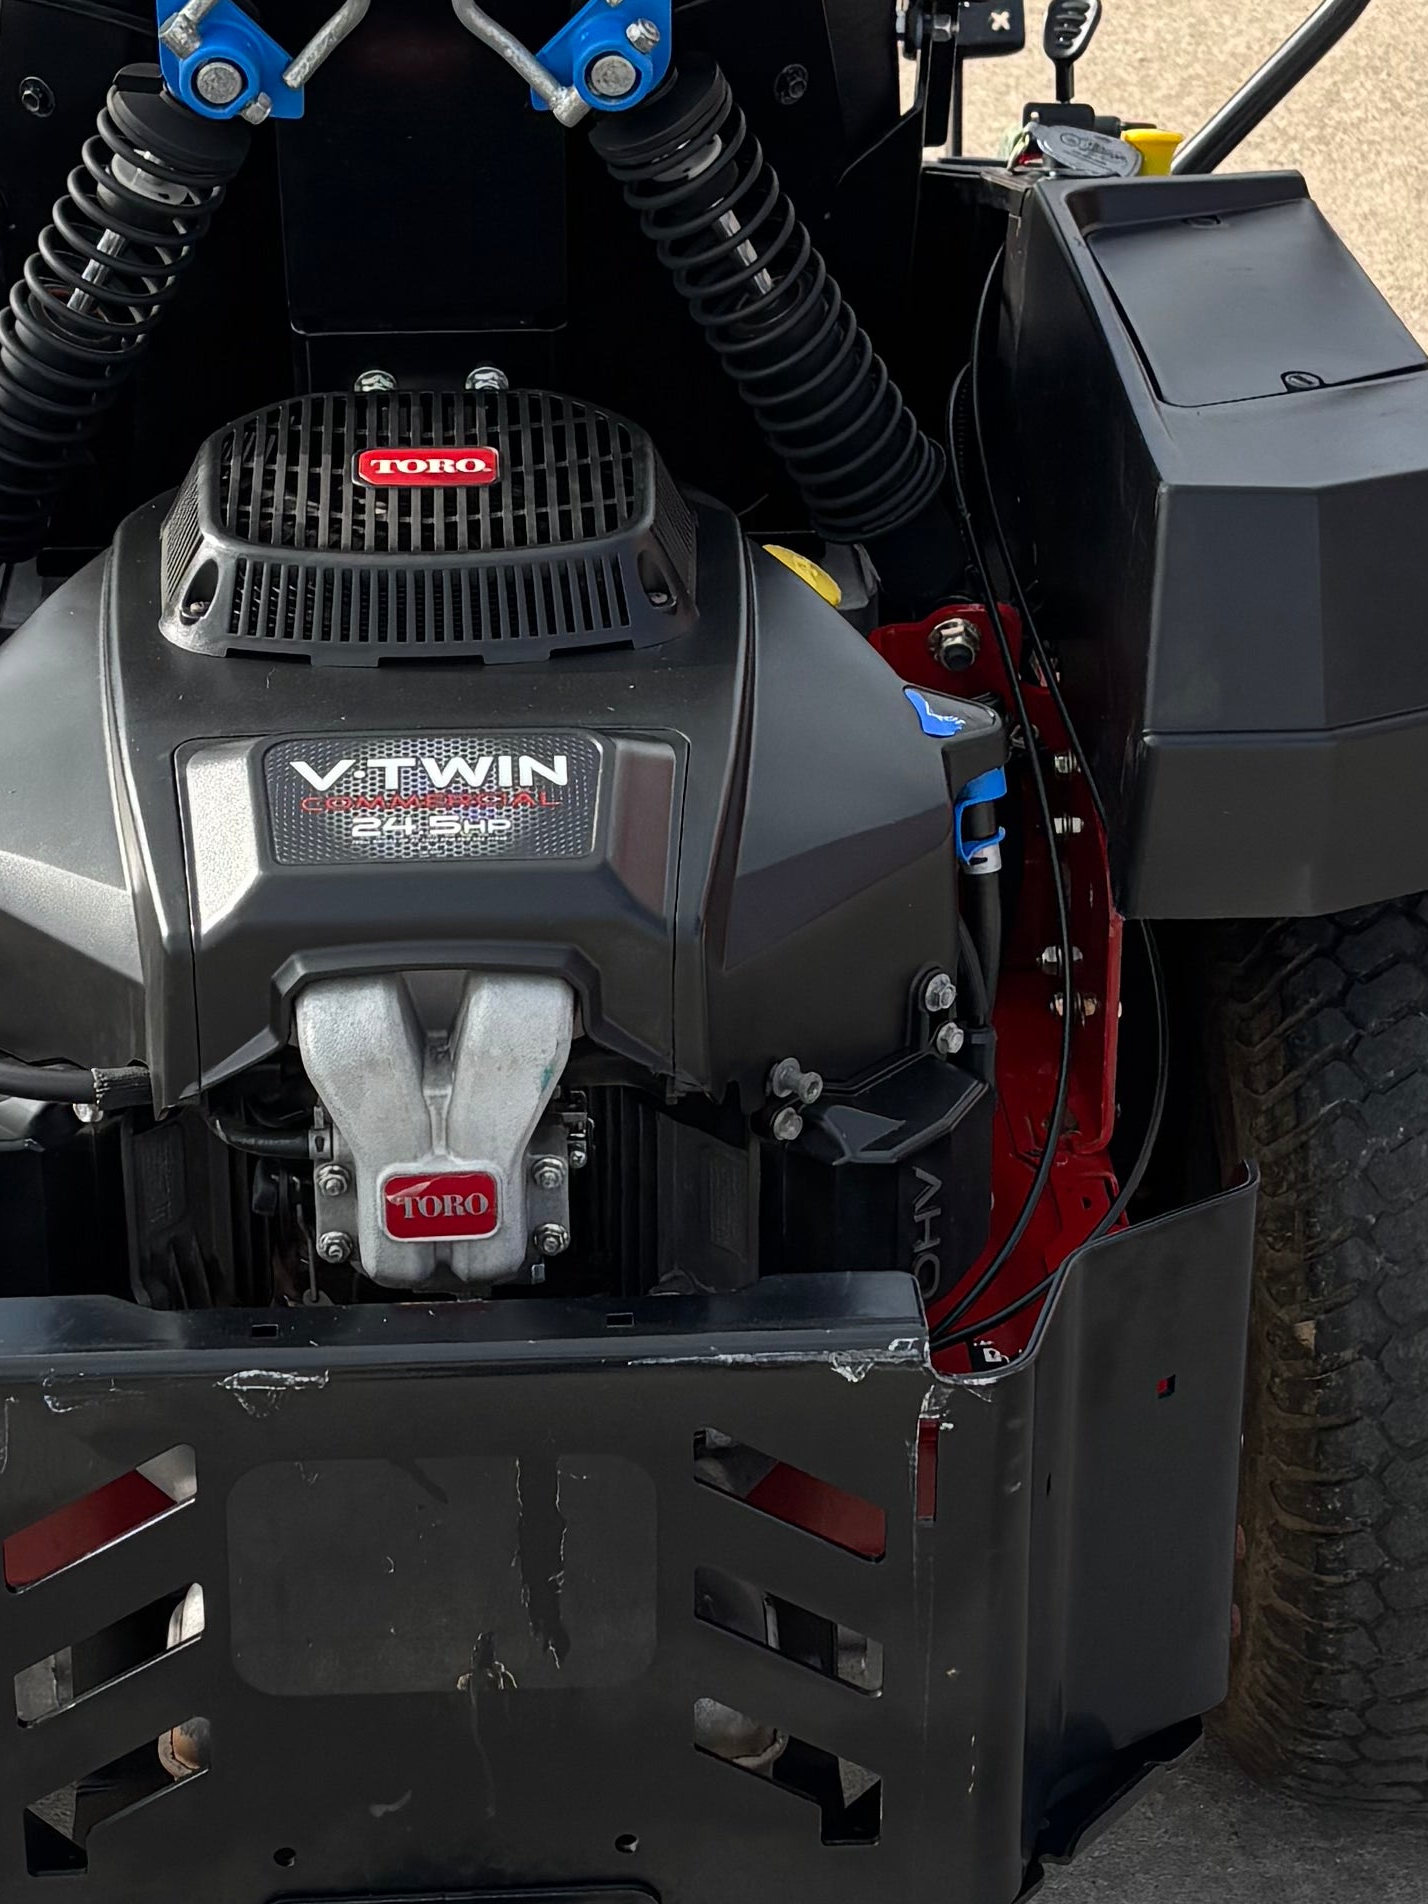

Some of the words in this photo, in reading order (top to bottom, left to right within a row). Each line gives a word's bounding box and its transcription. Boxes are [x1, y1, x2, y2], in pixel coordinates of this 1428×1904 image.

[370, 458, 488, 474] TORO
[301, 791, 563, 812] COMMERCIAL
[392, 1192, 490, 1219] TORO
[912, 1165, 943, 1300] OHV
